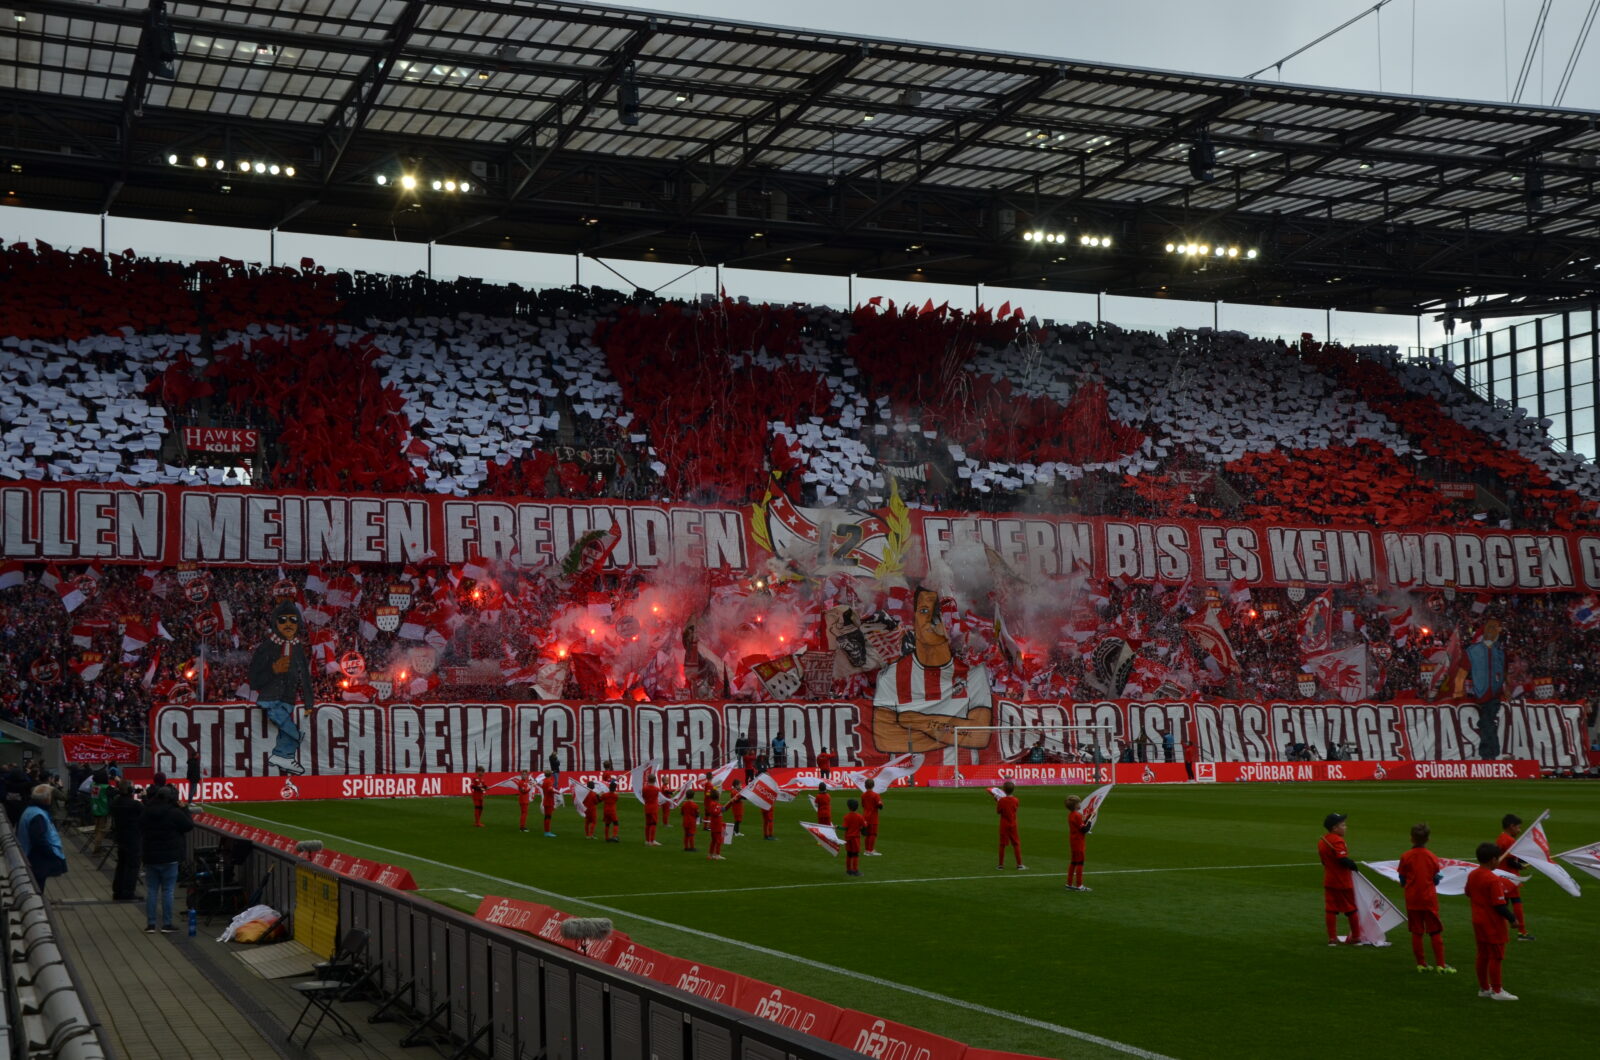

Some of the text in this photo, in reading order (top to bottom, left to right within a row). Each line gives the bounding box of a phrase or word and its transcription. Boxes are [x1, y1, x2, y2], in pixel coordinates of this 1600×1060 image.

[186, 427, 257, 448] HAWKS
[205, 443, 241, 453] KÖLN
[0, 489, 749, 570] LLEN MEINEN FREUNDEN
[817, 520, 860, 567] 12
[1105, 522, 1191, 580] BIS
[1200, 527, 1261, 582] ES
[1268, 528, 1374, 586] KEIN
[1383, 532, 1575, 589] MORGEN
[157, 702, 863, 779] STEH ICH BEIM FC IN DER KURVE
[1000, 702, 1069, 763] DER
[1073, 702, 1125, 763] FC
[1129, 703, 1192, 763] IST
[1195, 704, 1268, 762] DAS
[1272, 704, 1400, 762] EINZIGE
[1403, 703, 1481, 762] WAS
[997, 765, 1056, 781] SPÜRBAR
[1240, 762, 1294, 781] SPÜRBAR
[1415, 760, 1518, 779] SPÜRBAR ANDERS.
[342, 774, 417, 798] SPÜRBAR
[485, 899, 532, 929] DERTOUR
[676, 966, 726, 1001] DERTOUR
[754, 989, 816, 1035] DERTOUR
